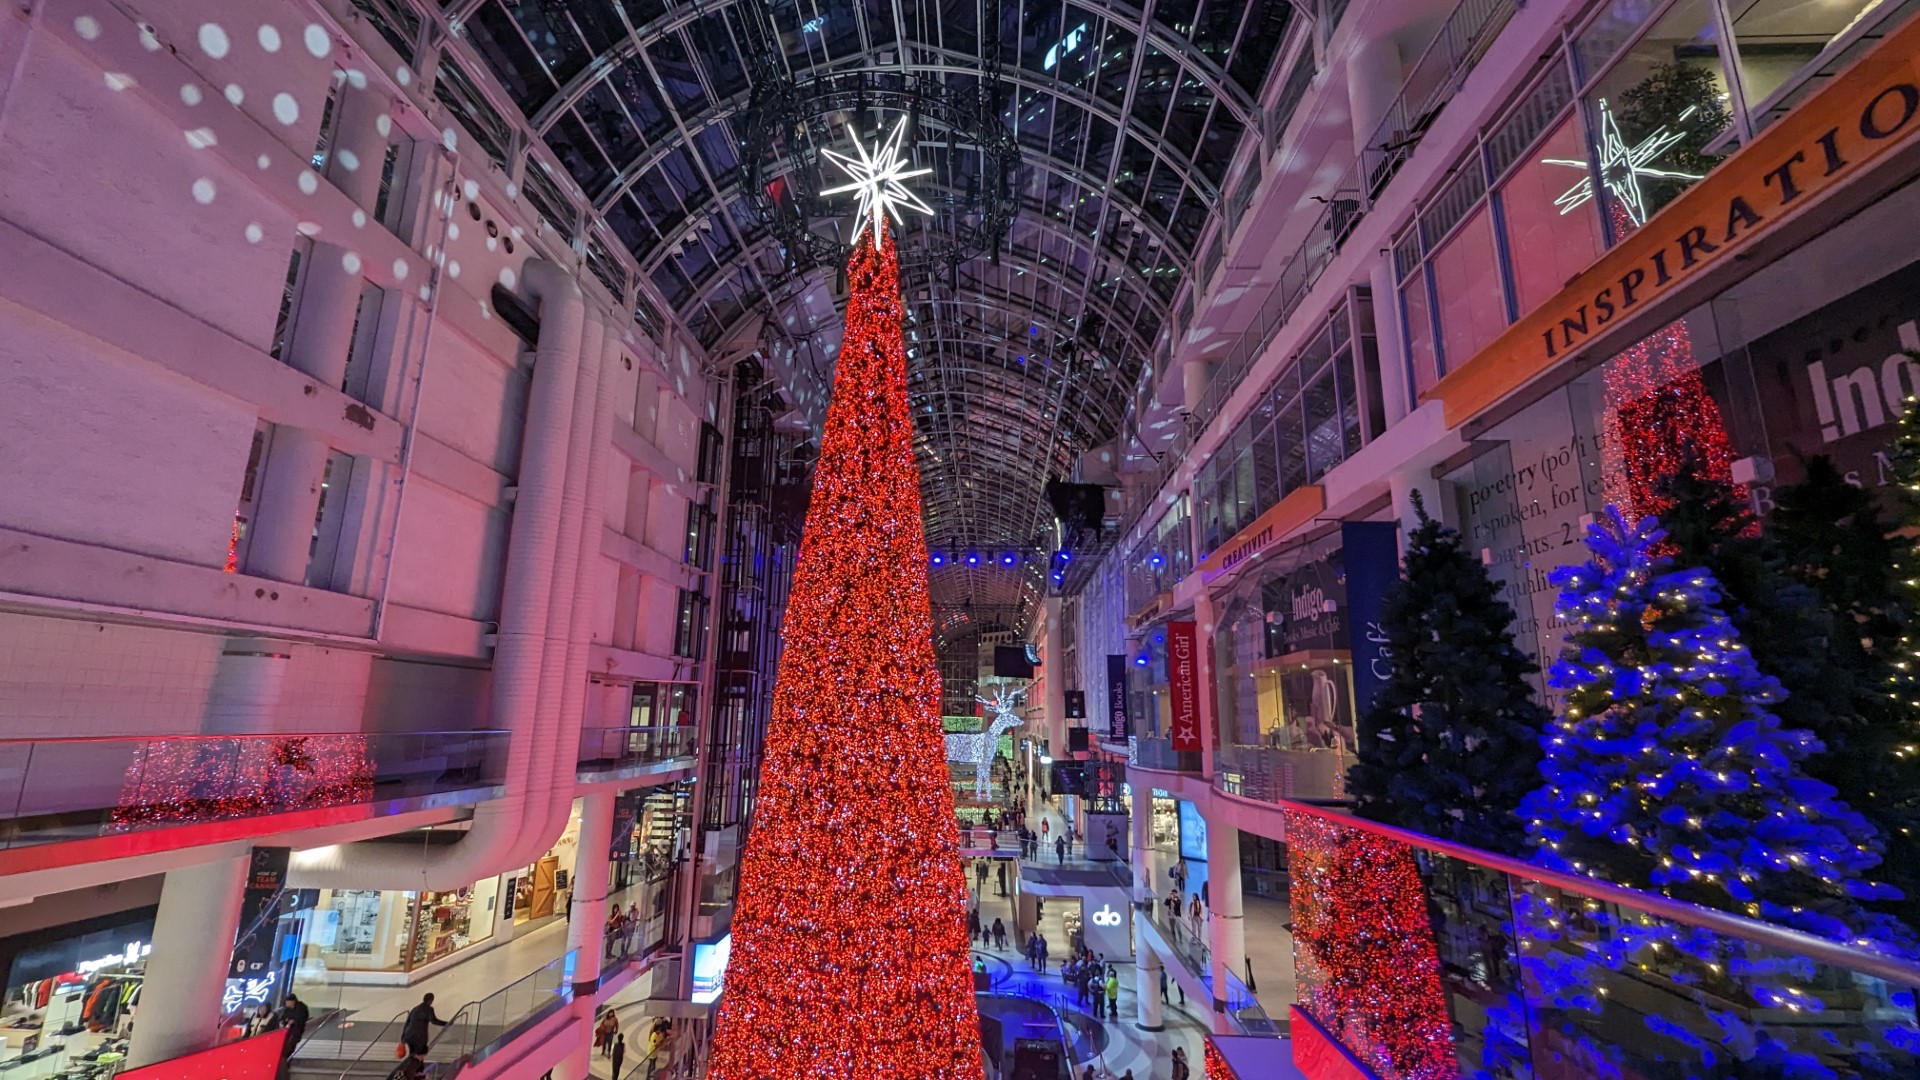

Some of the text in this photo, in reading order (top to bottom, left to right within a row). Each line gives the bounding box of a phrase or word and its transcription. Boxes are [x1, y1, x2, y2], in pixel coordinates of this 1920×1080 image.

[1551, 485, 1579, 509] for
[1223, 525, 1273, 570] CREATIVITY
[1292, 584, 1323, 621] Indigo
[1175, 635, 1193, 724] American Girl
[1112, 682, 1126, 738] Indigo Books
[1092, 904, 1122, 926] alo
